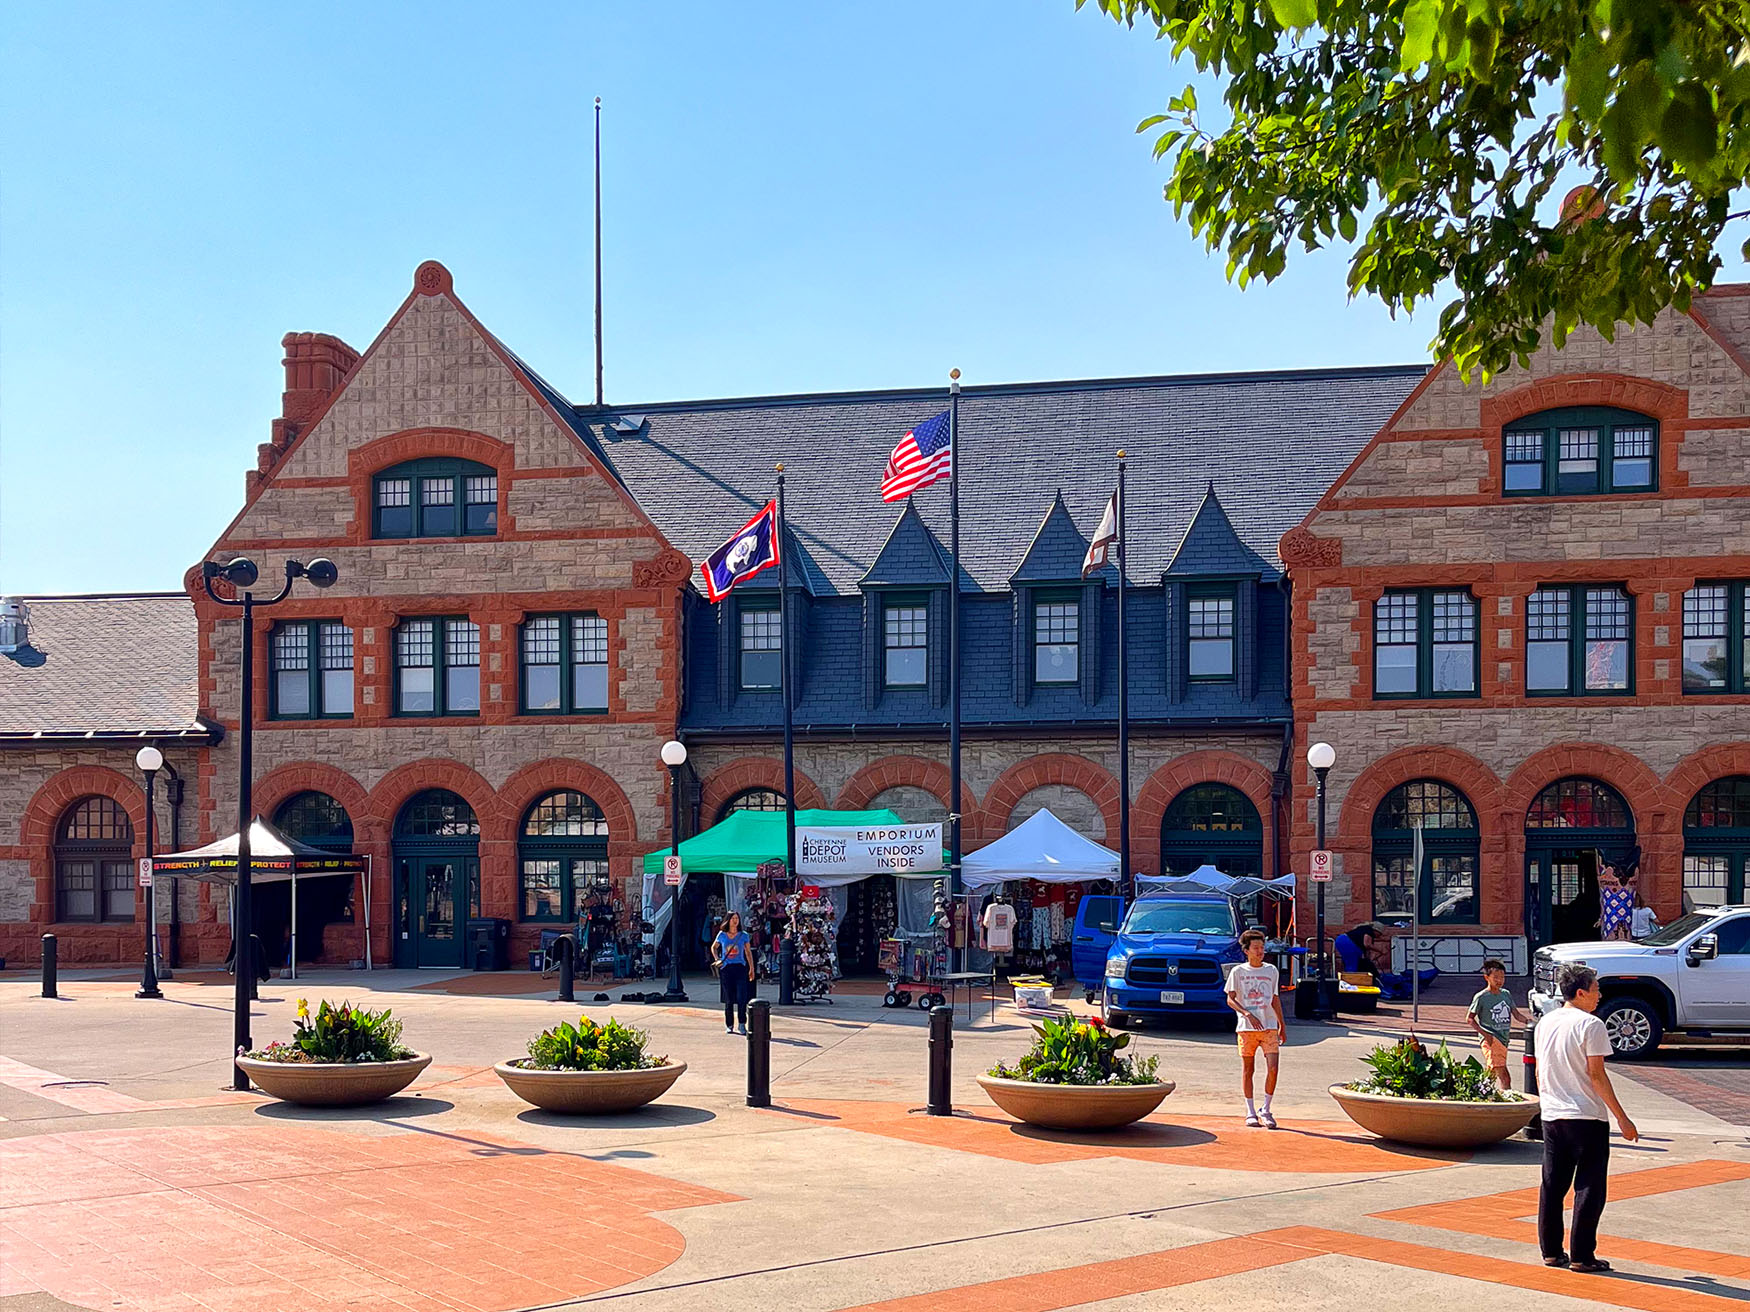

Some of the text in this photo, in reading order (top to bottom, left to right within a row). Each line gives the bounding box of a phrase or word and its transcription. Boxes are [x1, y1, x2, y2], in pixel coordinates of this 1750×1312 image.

[857, 829, 936, 841] EMPORIUM
[810, 845, 847, 856] DEPOT
[868, 845, 924, 856] VENDORS
[154, 861, 200, 870] STRENGTH
[250, 861, 291, 869] PROTECT
[810, 856, 847, 864] MUSEUM
[877, 857, 915, 868] INSIDE
